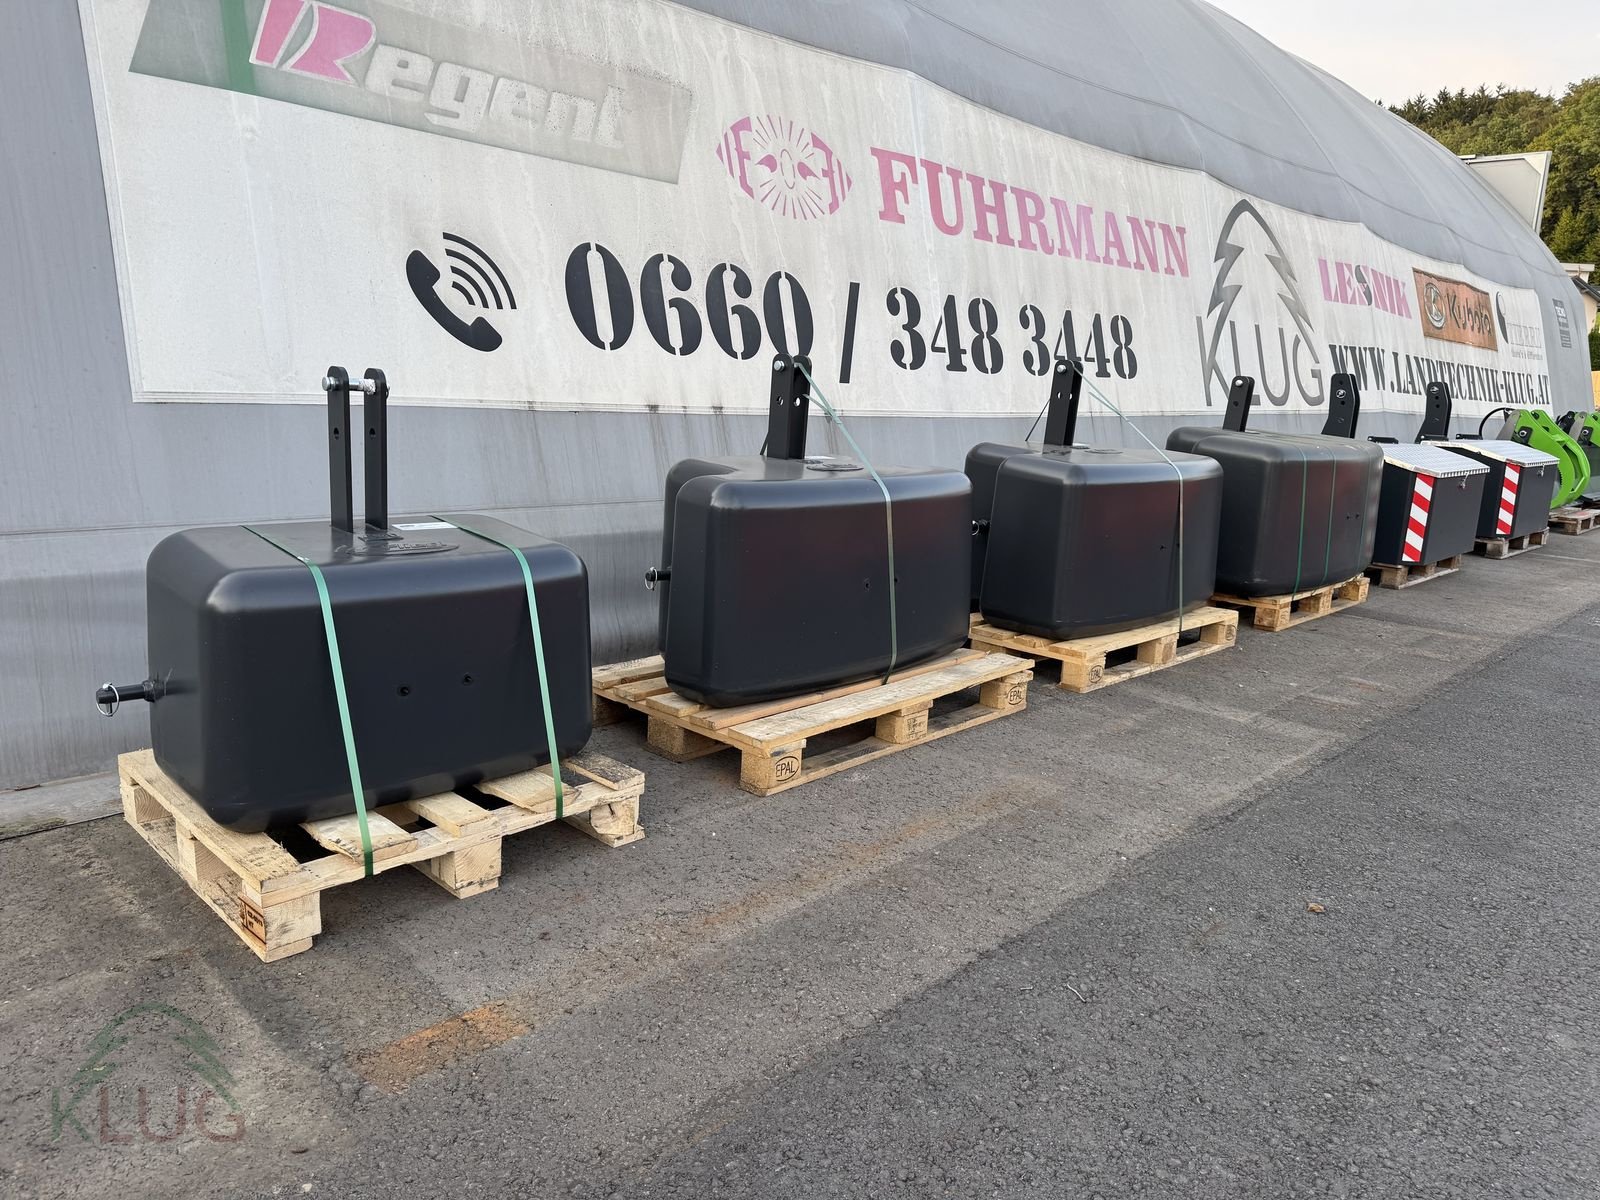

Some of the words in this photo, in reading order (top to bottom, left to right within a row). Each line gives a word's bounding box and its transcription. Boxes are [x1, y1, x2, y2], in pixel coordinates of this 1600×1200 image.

[249, 0, 632, 149] Regent
[870, 147, 1190, 278] FUHRMANN
[565, 242, 814, 360] 0660
[886, 287, 1004, 375] 348
[1019, 304, 1138, 380] 3448
[1196, 316, 1325, 406] KLUG
[1446, 291, 1492, 336] Kubota
[775, 760, 795, 777] EPAL
